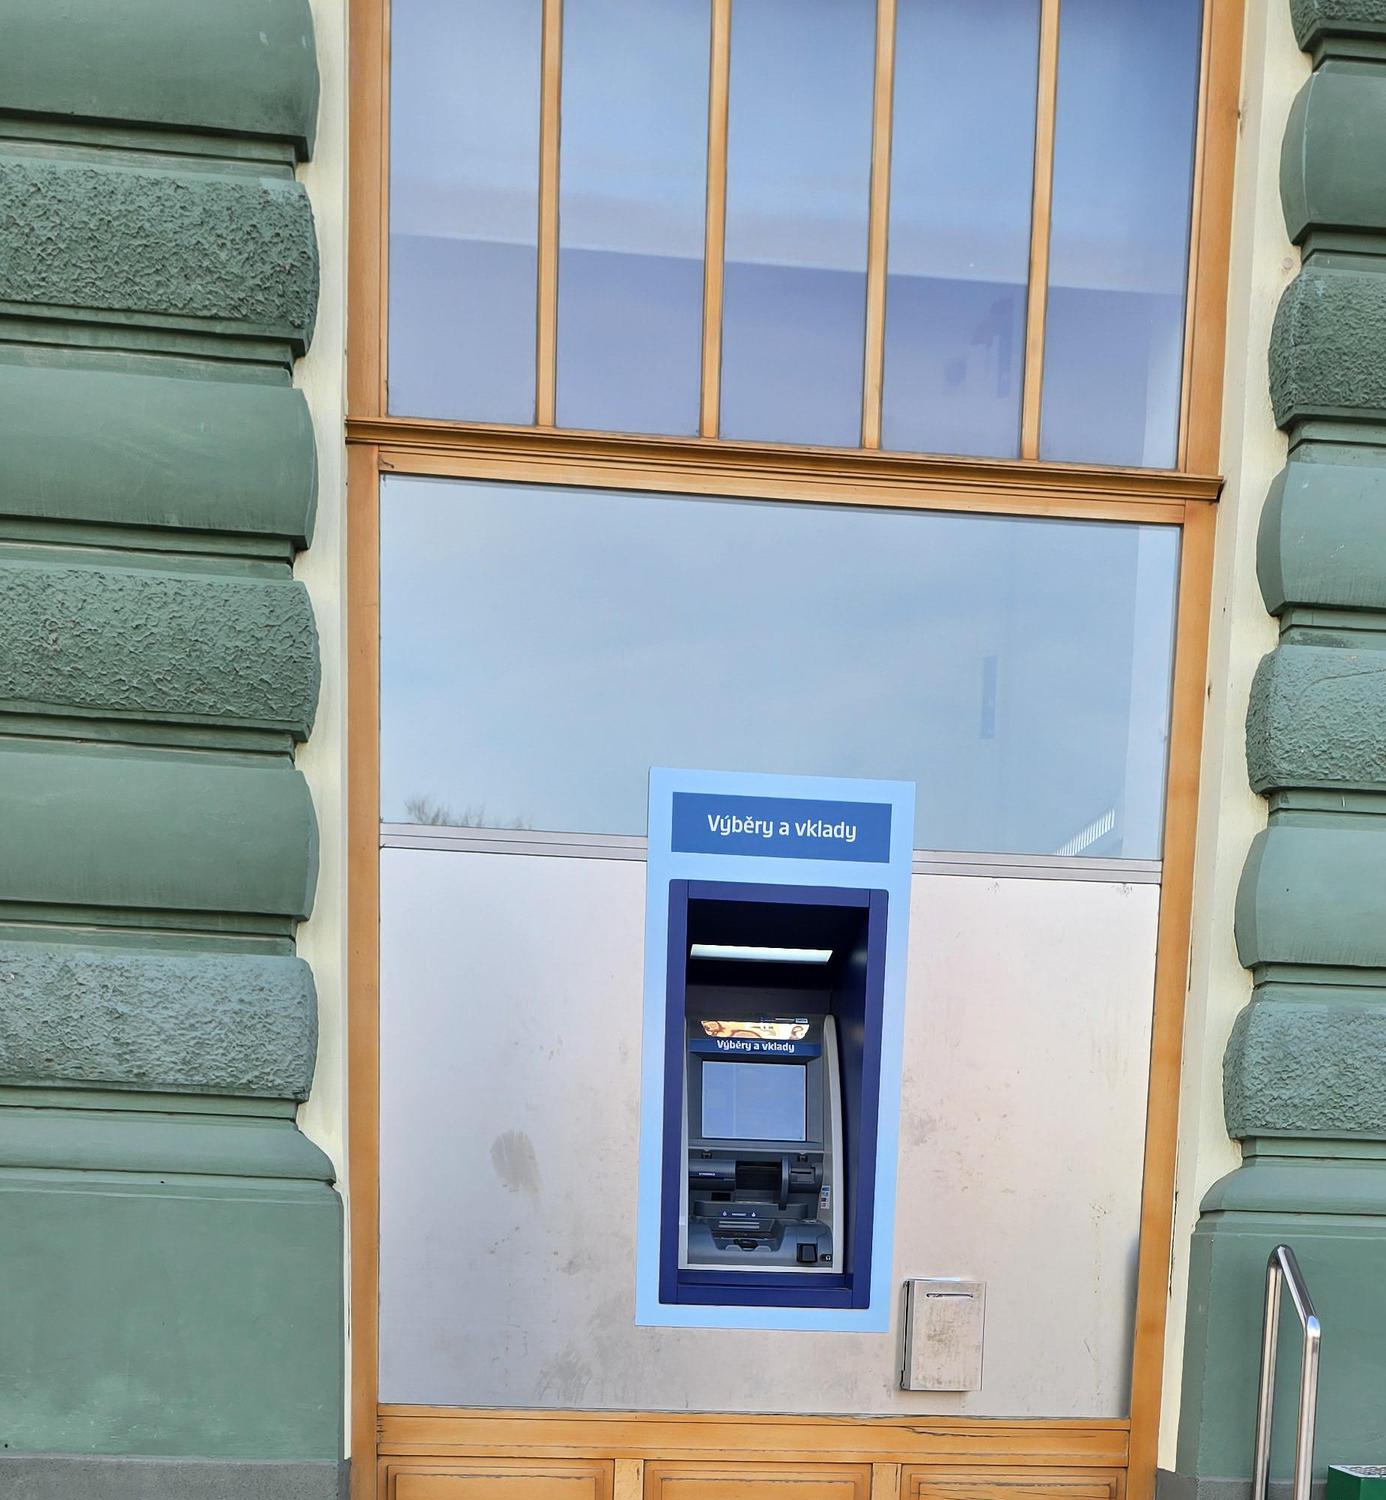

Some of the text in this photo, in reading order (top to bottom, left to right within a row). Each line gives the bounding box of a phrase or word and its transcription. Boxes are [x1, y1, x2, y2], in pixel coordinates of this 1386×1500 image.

[707, 814, 857, 843] Výběry a vklady
[762, 1041, 795, 1053] vklady
